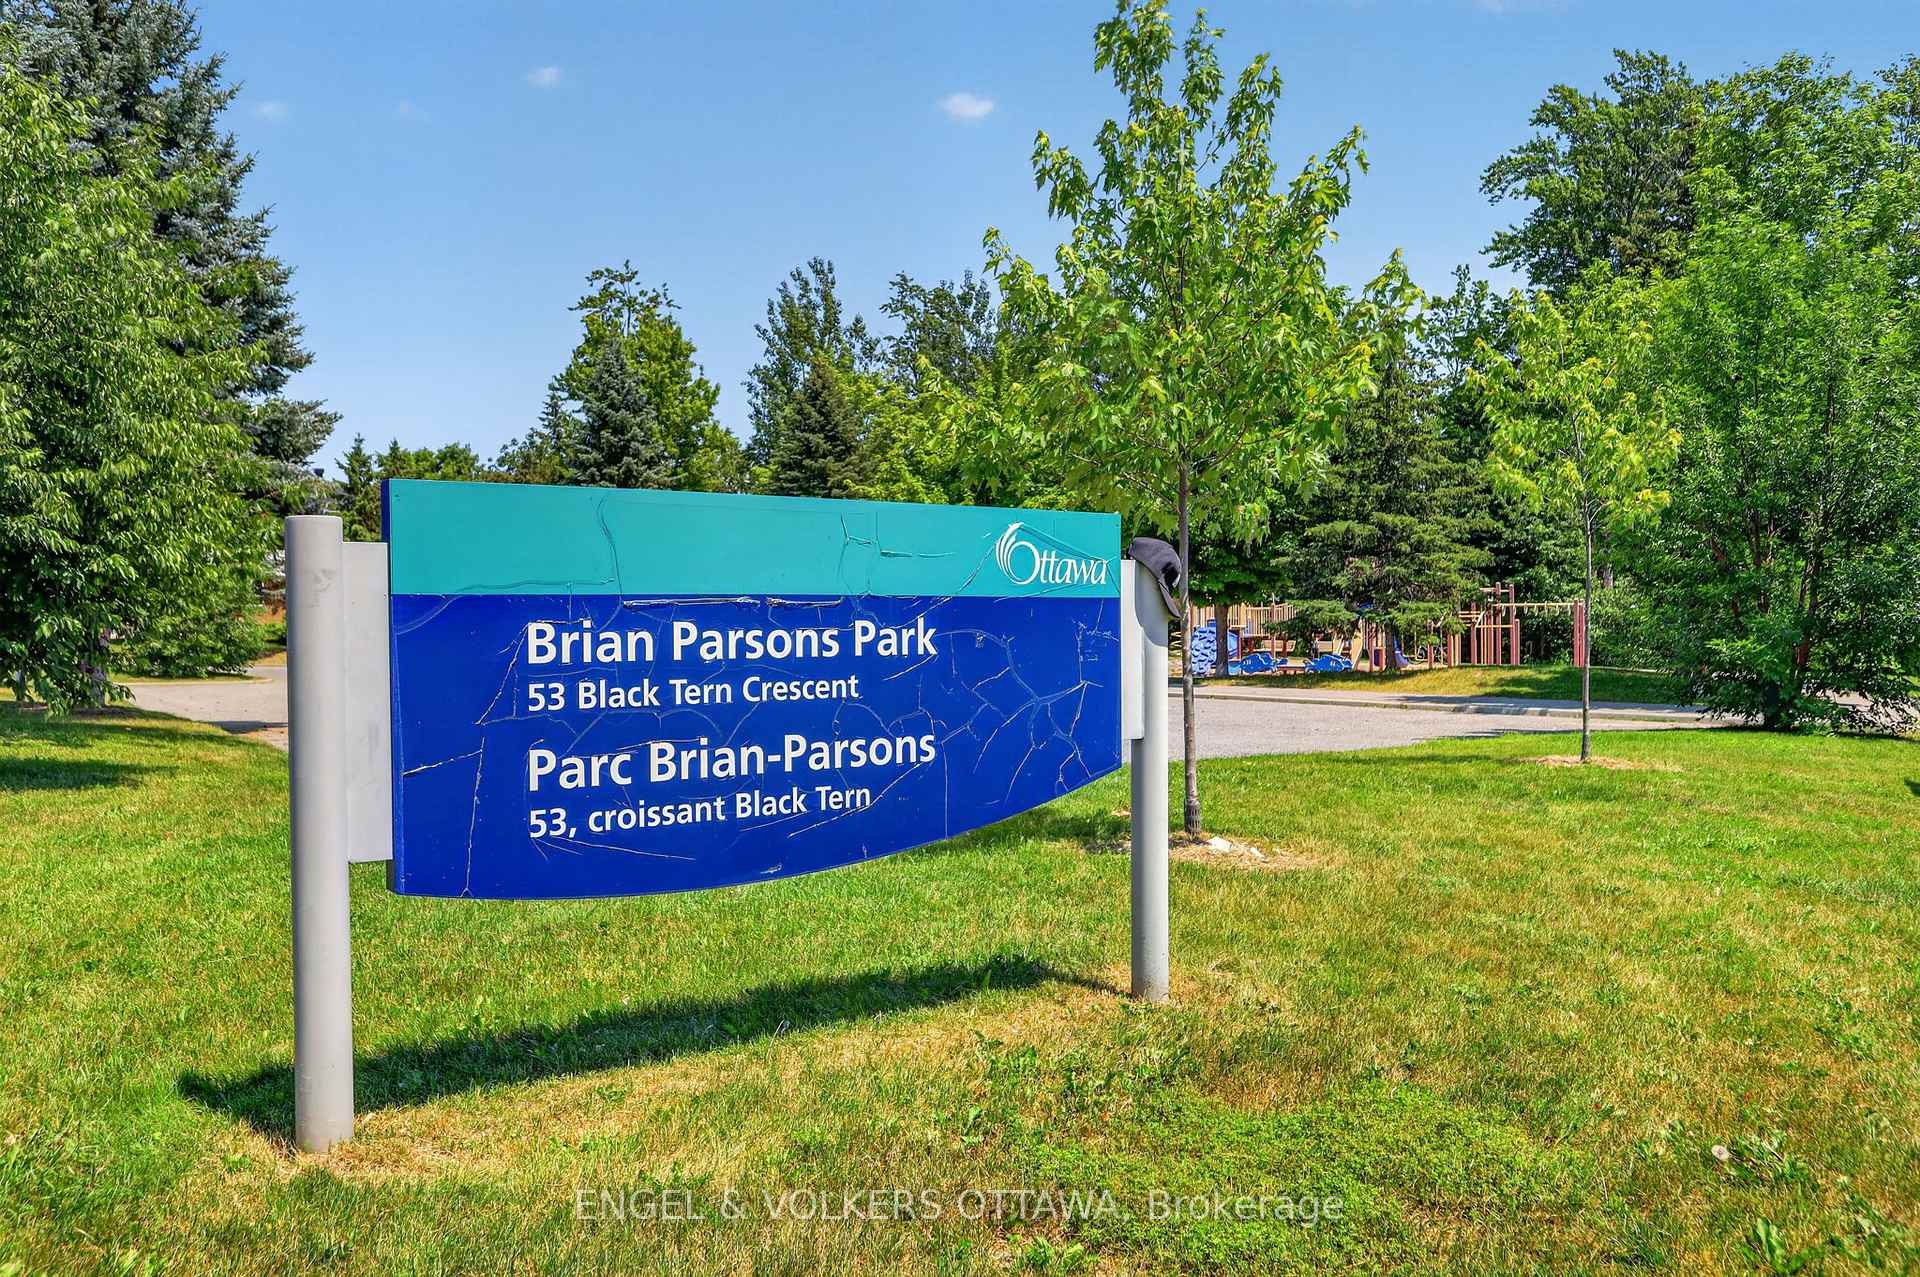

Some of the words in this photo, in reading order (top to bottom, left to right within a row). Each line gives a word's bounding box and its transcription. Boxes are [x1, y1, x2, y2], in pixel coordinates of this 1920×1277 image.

[996, 524, 1107, 585] Ottawa
[528, 619, 654, 665] Brian
[673, 621, 840, 661] Parsons
[855, 617, 938, 657] Park
[529, 683, 565, 712] 53
[579, 679, 660, 709] Black
[669, 679, 732, 705] Tern
[743, 675, 859, 702] Crescent
[529, 750, 632, 792] Parc
[650, 735, 936, 783] Brian-Parsons
[530, 808, 577, 838] 53,
[589, 797, 726, 832] croissant
[736, 788, 807, 819] Black
[815, 786, 871, 812] Tern
